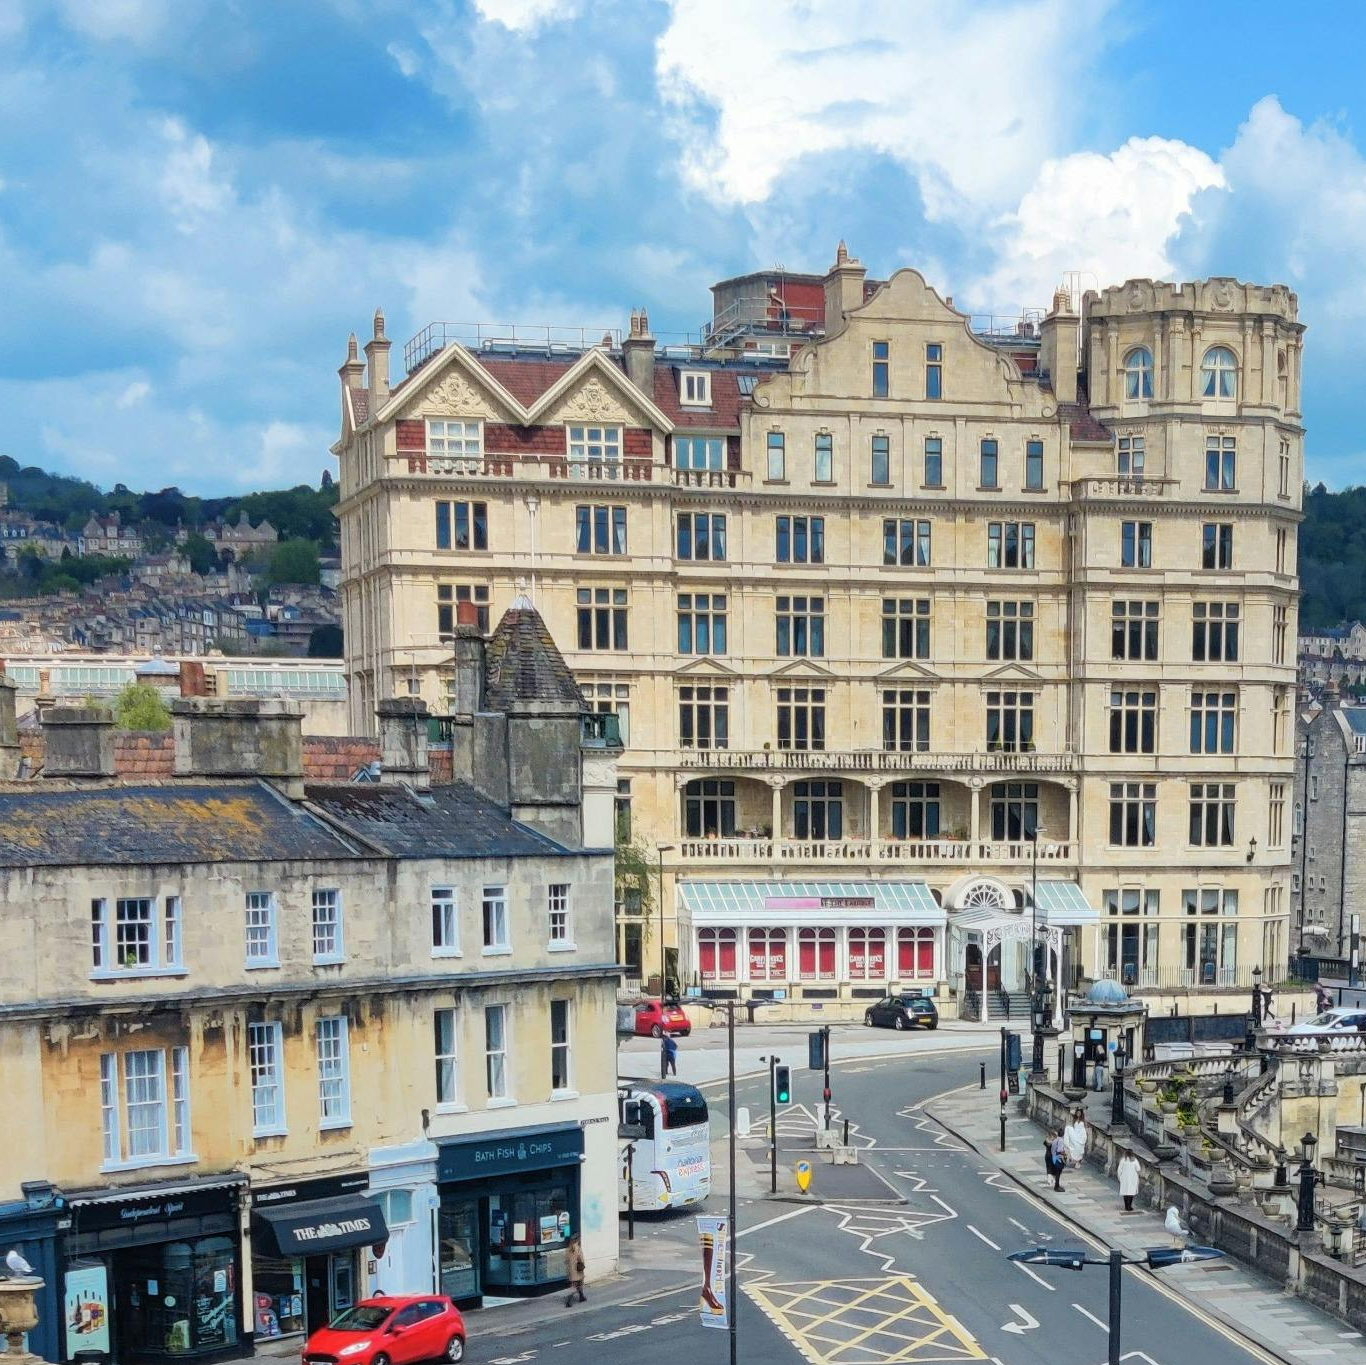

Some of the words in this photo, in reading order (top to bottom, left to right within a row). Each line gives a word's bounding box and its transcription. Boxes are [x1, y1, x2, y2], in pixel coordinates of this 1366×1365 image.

[475, 1150, 495, 1162] BATH
[497, 1148, 515, 1160] FISH
[529, 1142, 552, 1155] CHIPS
[293, 1227, 318, 1241] THE
[337, 1218, 371, 1234] TIMES
